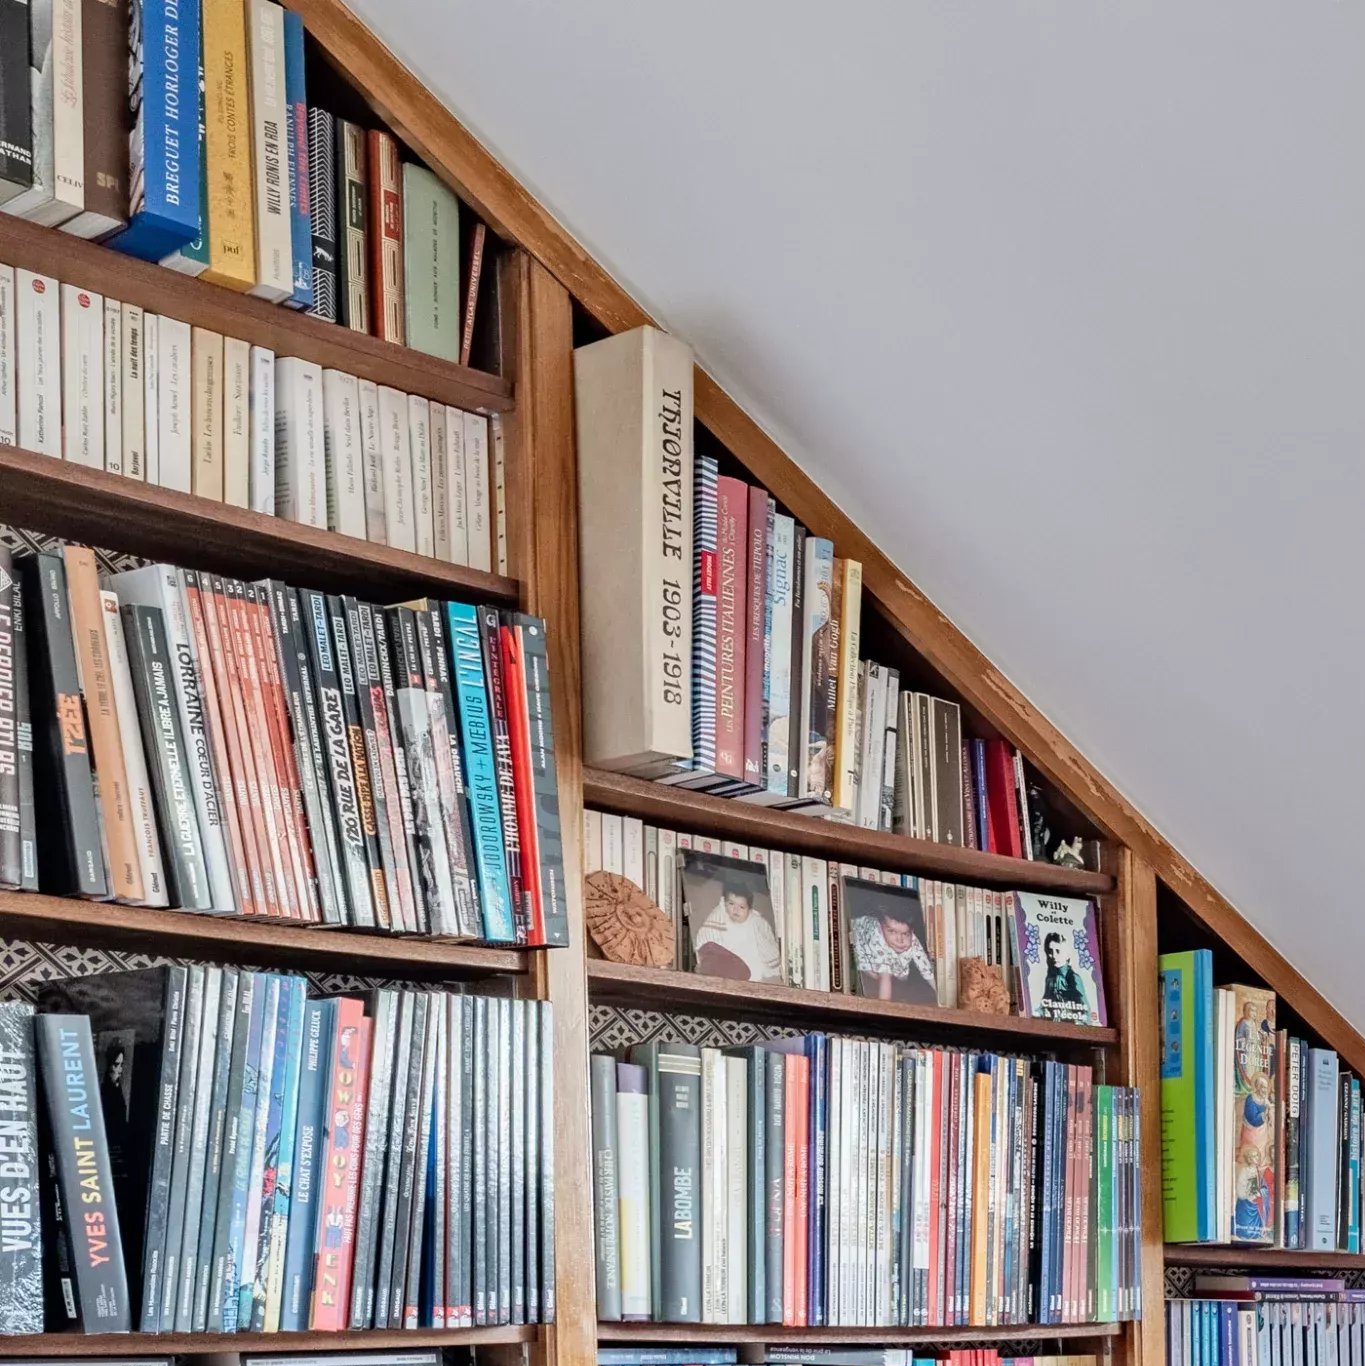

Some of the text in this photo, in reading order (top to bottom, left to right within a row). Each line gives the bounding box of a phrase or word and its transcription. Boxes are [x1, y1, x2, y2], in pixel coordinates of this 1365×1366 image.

[165, 25, 180, 206] BREGUET HORLOGER
[227, 98, 236, 133] CONTES
[266, 142, 282, 216] WILLY RONIS EN
[465, 250, 481, 326] ATLAS UNIVERSEL
[52, 593, 62, 620] APOLLO
[752, 528, 763, 641] LES FRESQUES DE TIEPOLO
[771, 549, 791, 607] Signac
[14, 608, 23, 632] ENKI
[313, 596, 332, 670] LEO MALET-TARDI
[334, 619, 354, 692] LEO MALET-TARDI
[359, 606, 378, 679] LEO MALET-TARDI
[431, 610, 448, 683] TARDI PENNAC
[454, 614, 485, 687] L'INCAL
[662, 577, 684, 705] 1903-1918
[720, 547, 736, 733] LES PEINTURES ITALIENNES
[827, 619, 841, 712] Millet Van Gogh
[17, 721, 33, 752] BUG
[176, 642, 219, 826] LORRAINE D'ACIER
[301, 665, 322, 752] LABYRINTHE INFERNAL
[532, 656, 545, 748] MOORE DAVE GIBBONS
[153, 661, 196, 856] LA GUERRE JAMAIS
[322, 687, 356, 811] RUE DE LA GARE
[349, 727, 364, 760] NATION
[450, 734, 464, 794] LA DÉBAUCHE
[138, 787, 155, 858] FRANÇOIS TRUFFAUT
[473, 773, 502, 872] JODOROWSKY
[494, 733, 521, 852] L'HOMME DE JAVA
[548, 869, 558, 914] WATCHMEN
[1036, 913, 1074, 926] Colette
[1038, 899, 1069, 913] Willy
[307, 1009, 321, 1071] PHILIPPE GELUCK
[1041, 998, 1089, 1012] Claudine
[59, 1029, 92, 1131] LAURENT
[1235, 1038, 1273, 1057] LÉGENDE
[1240, 1052, 1269, 1069] DORÉE
[1290, 1044, 1301, 1114] PETER DOIG
[160, 1083, 174, 1146] PARTIE DE CHASSE
[353, 1103, 363, 1121] GENS
[1349, 1090, 1359, 1161] histoire des arts
[0, 1047, 33, 1253] VUES D'EN HAUT
[74, 1137, 102, 1205] SAINT
[298, 1125, 314, 1204] LE CHAT S'EXPOSE
[85, 1212, 111, 1268] YVES
[605, 1213, 616, 1289] NOTRE ENFANCE
[393, 1288, 402, 1318] DARGAUD
[770, 1353, 816, 1362] DON WINSLOW
